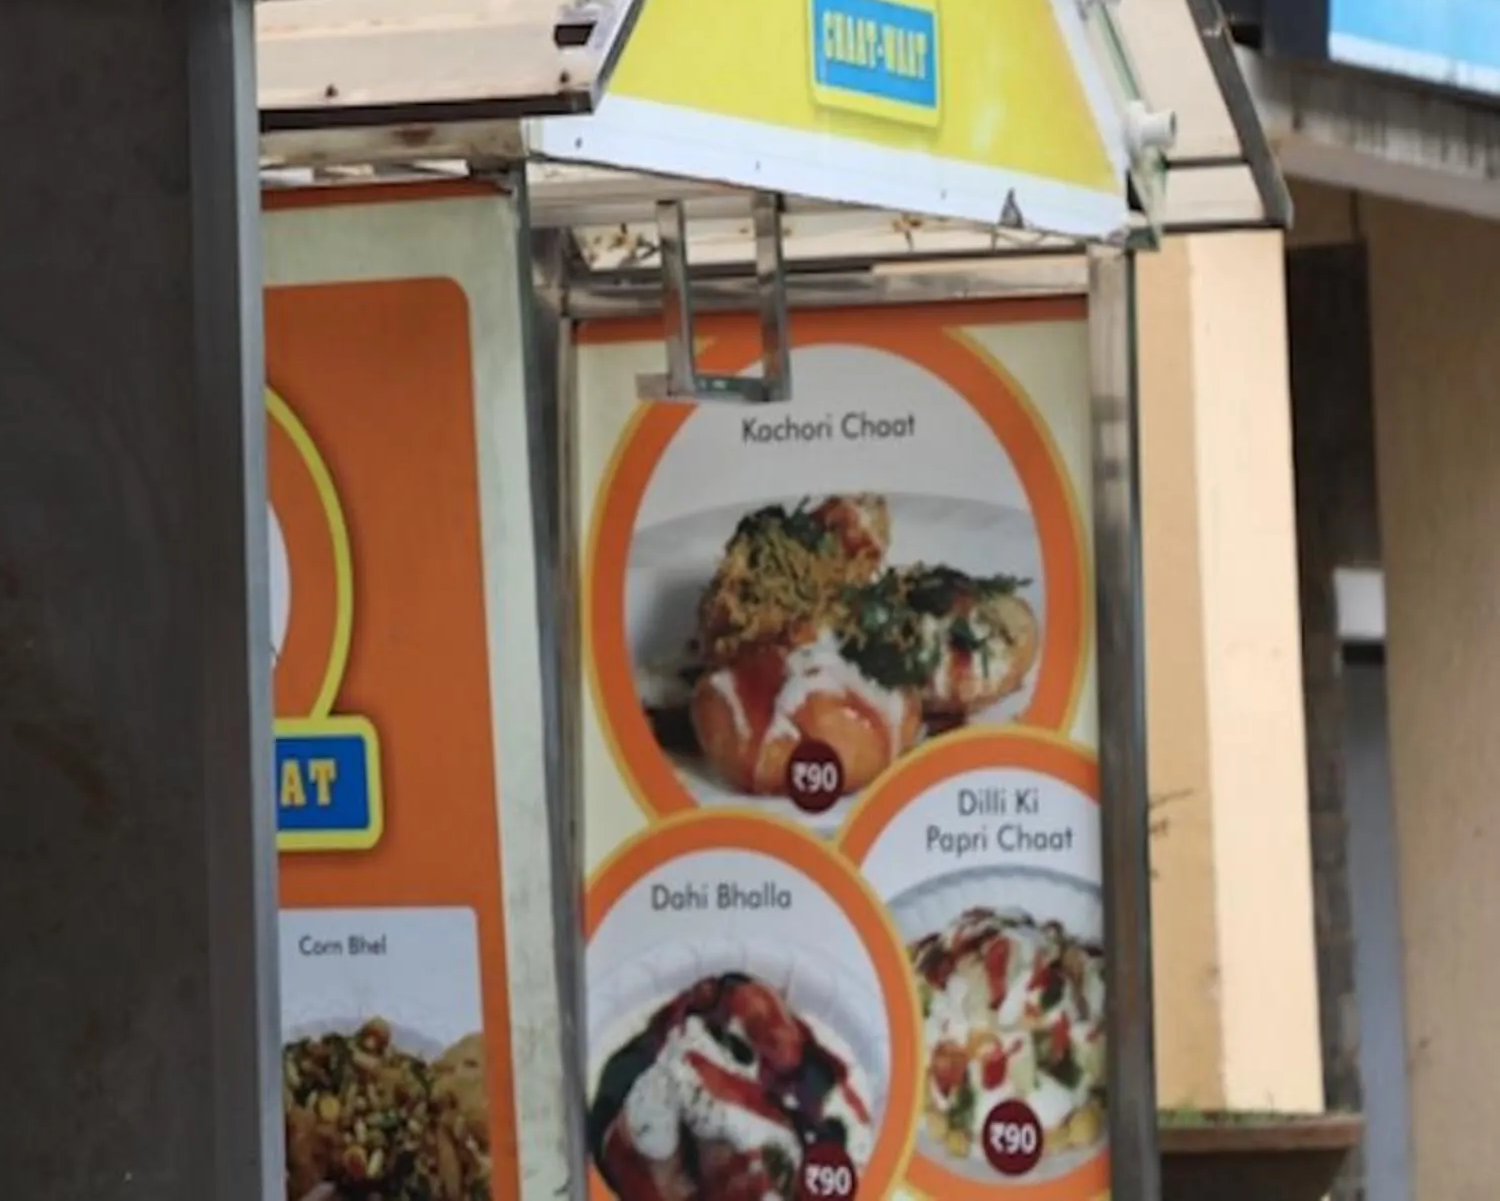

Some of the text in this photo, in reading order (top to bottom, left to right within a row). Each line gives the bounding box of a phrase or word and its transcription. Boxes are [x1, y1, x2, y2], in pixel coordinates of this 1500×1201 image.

[742, 410, 915, 445] Kachori Chaat
[280, 758, 337, 807] AT
[792, 760, 838, 793] ₹90
[957, 787, 1040, 816] Dilli Ki
[925, 823, 1074, 858] Papri Chaat
[651, 880, 792, 911] Dahi Bhalla
[298, 932, 387, 956] Corn Bhel
[989, 1121, 1038, 1155] ₹90
[805, 1164, 851, 1197] ₹90
